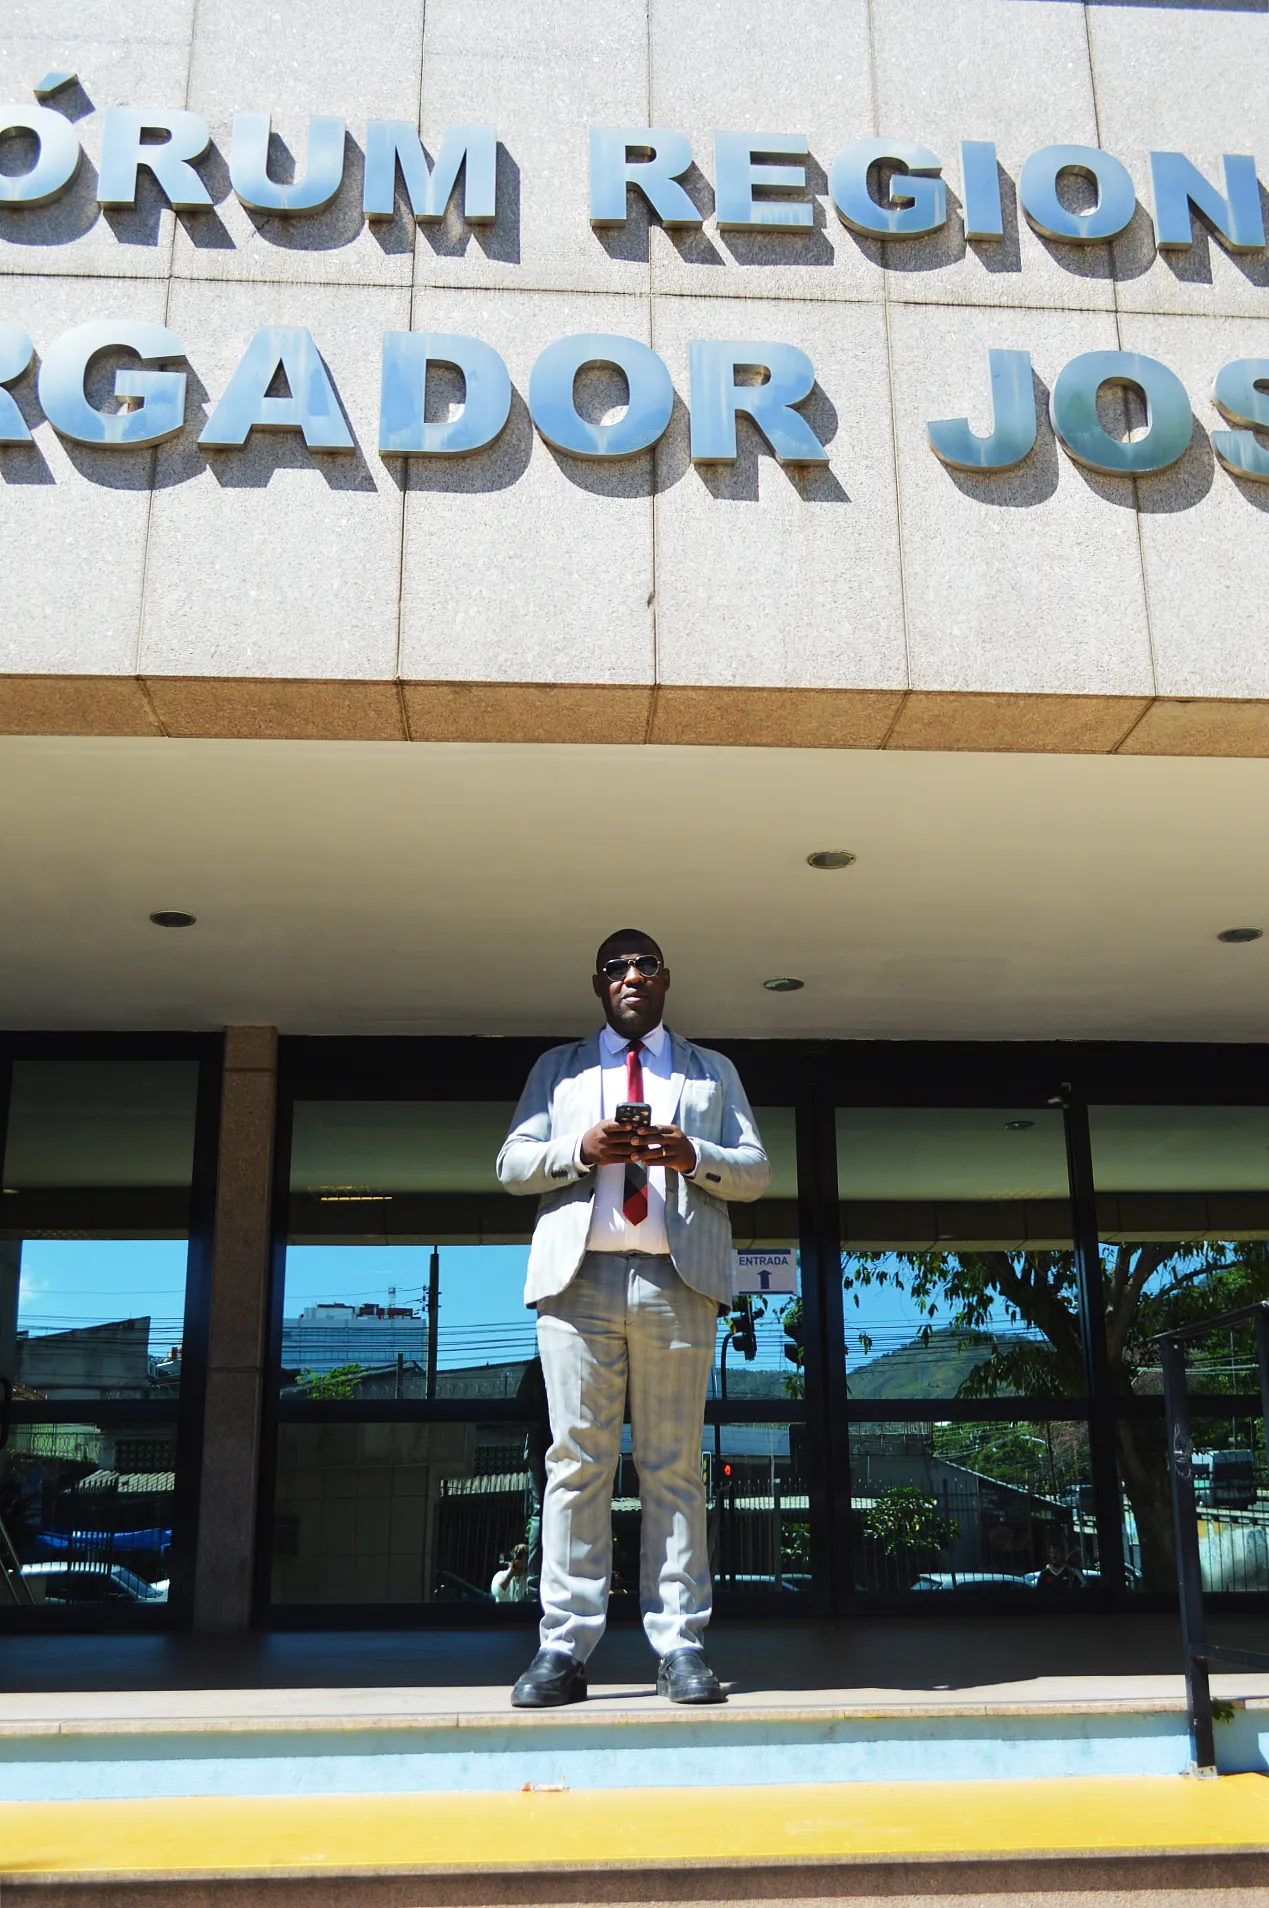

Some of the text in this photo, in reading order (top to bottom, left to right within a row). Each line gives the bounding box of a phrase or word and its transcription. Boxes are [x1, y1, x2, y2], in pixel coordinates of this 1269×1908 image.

[0, 72, 1267, 254] ÓRUM REGION
[0, 318, 831, 467] GADOR
[739, 1256, 789, 1266] ENTRADA
